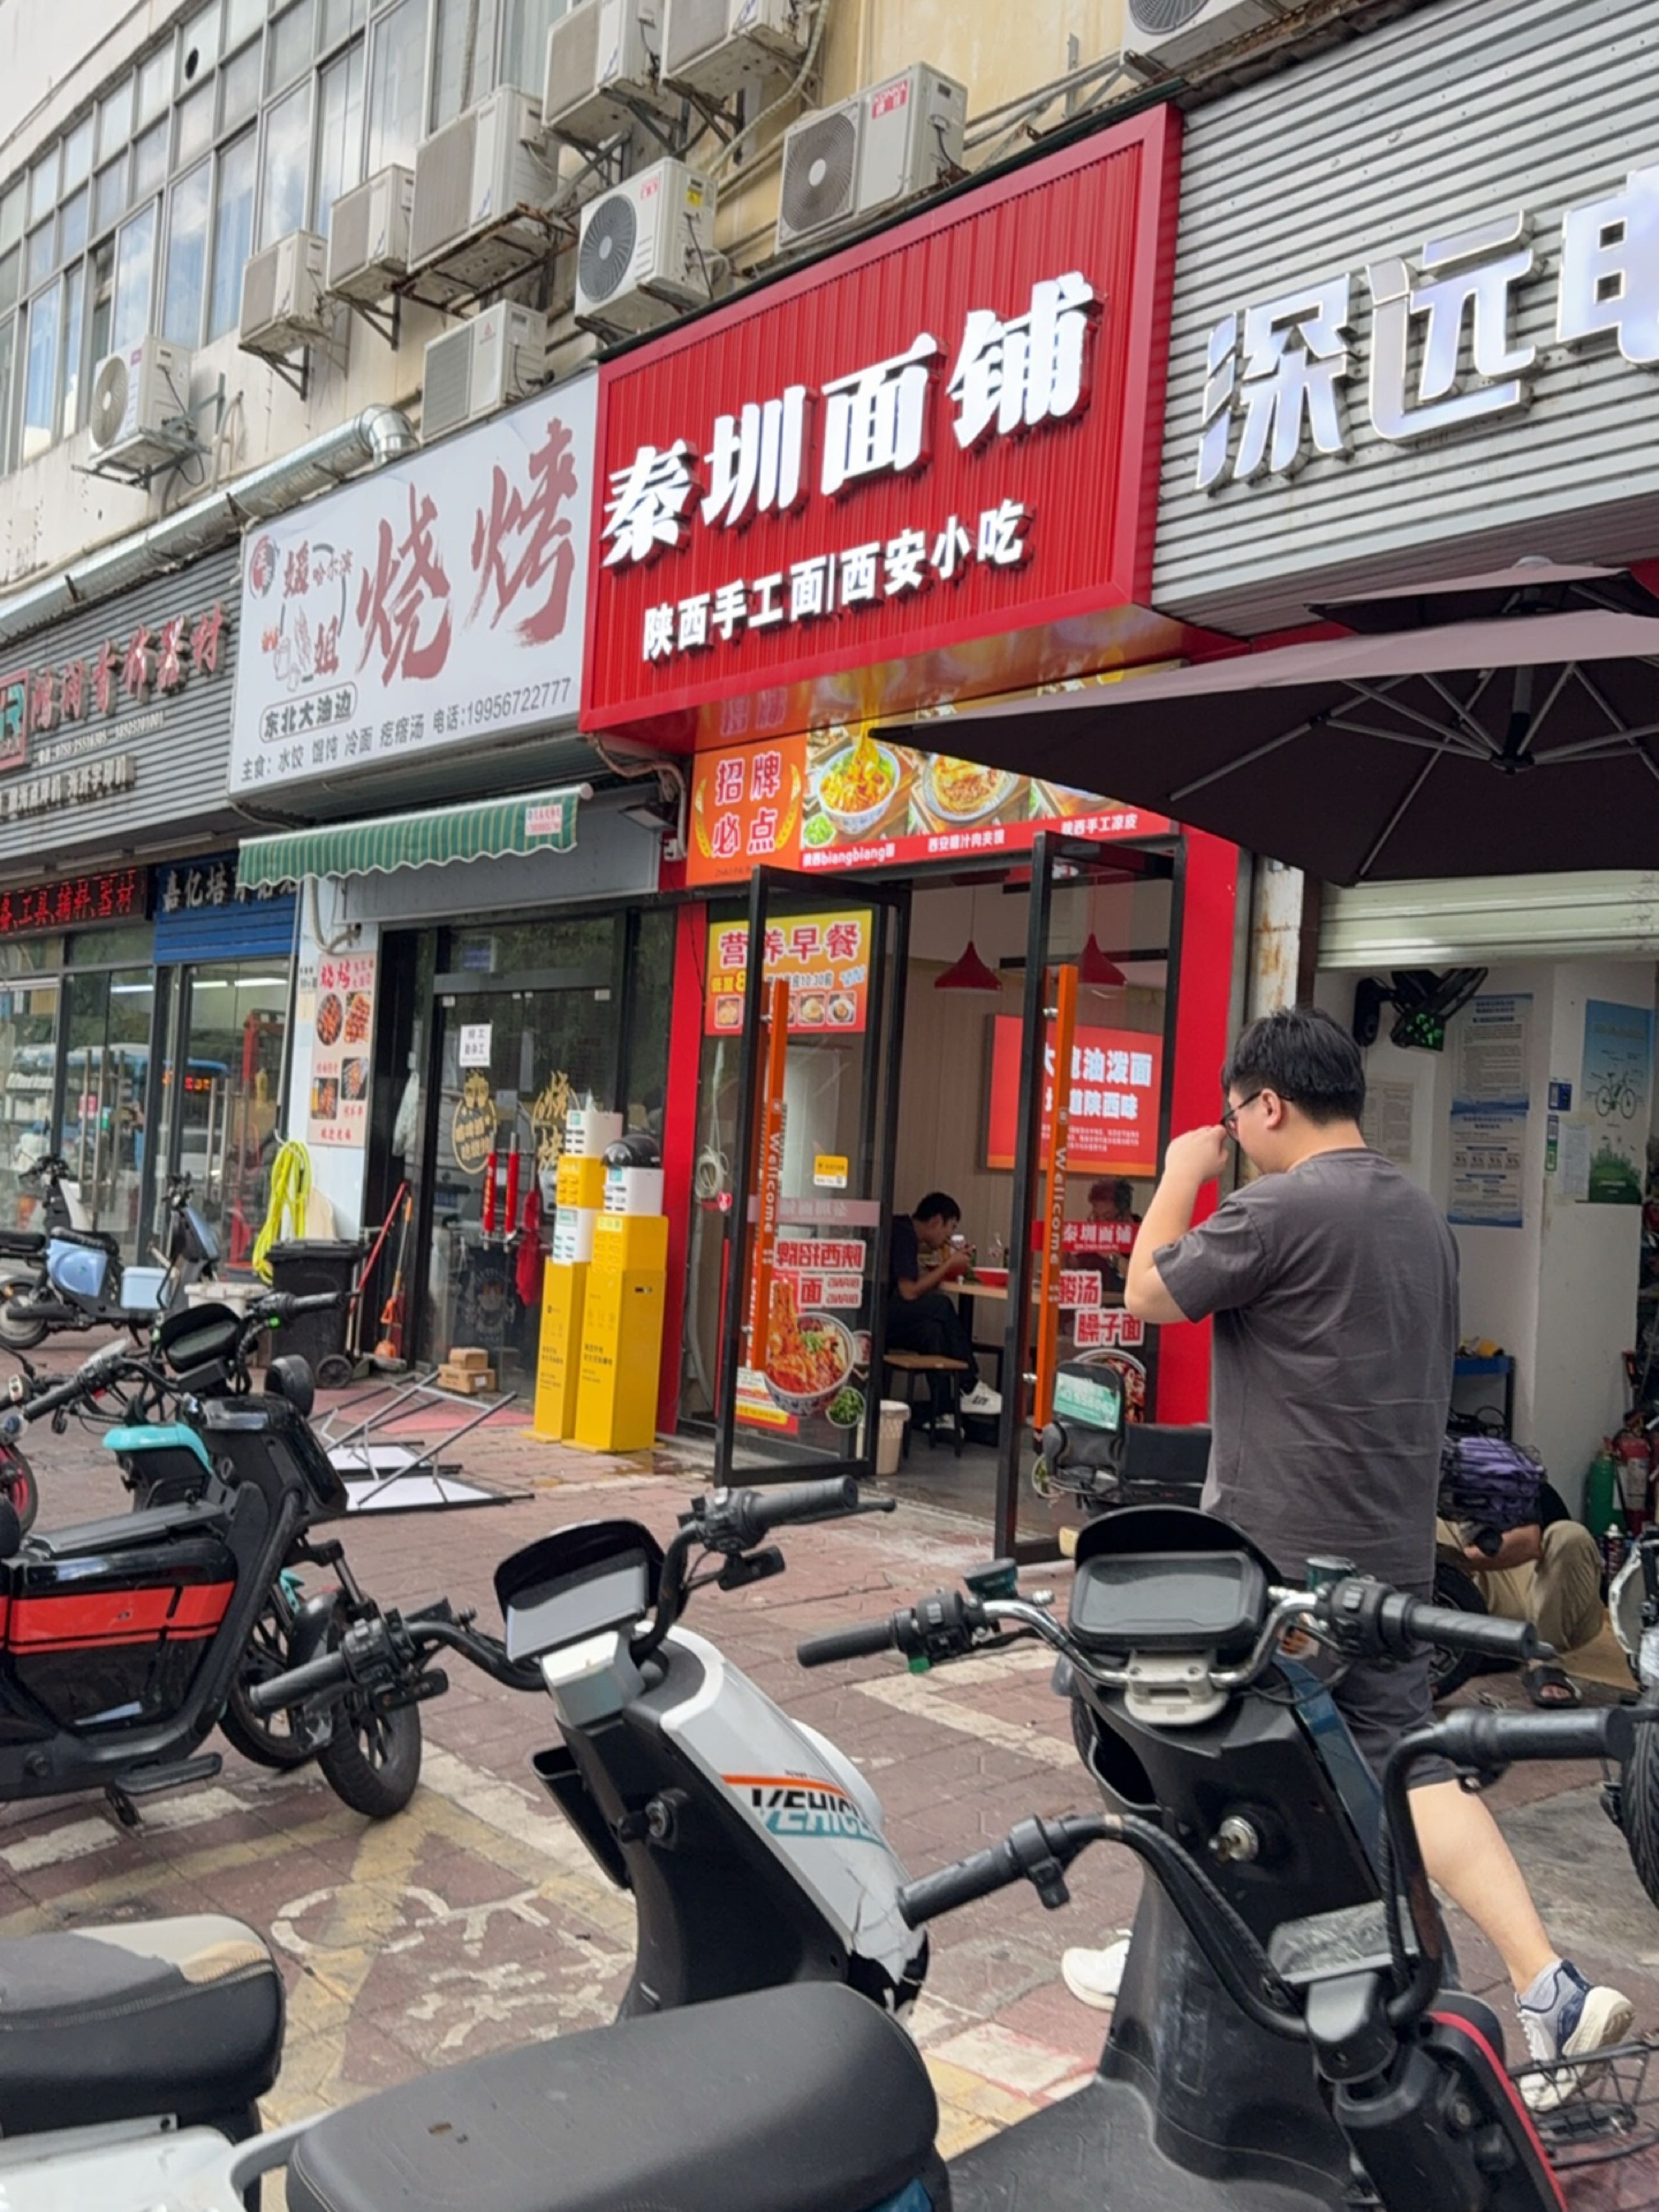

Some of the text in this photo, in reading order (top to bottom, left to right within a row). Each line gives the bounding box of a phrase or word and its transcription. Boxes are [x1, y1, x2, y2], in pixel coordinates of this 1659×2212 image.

[600, 270, 1094, 568] 秦圳面铺
[355, 417, 578, 687] 烧烤
[710, 806, 779, 859] 必点
[714, 750, 782, 806] 招牌
